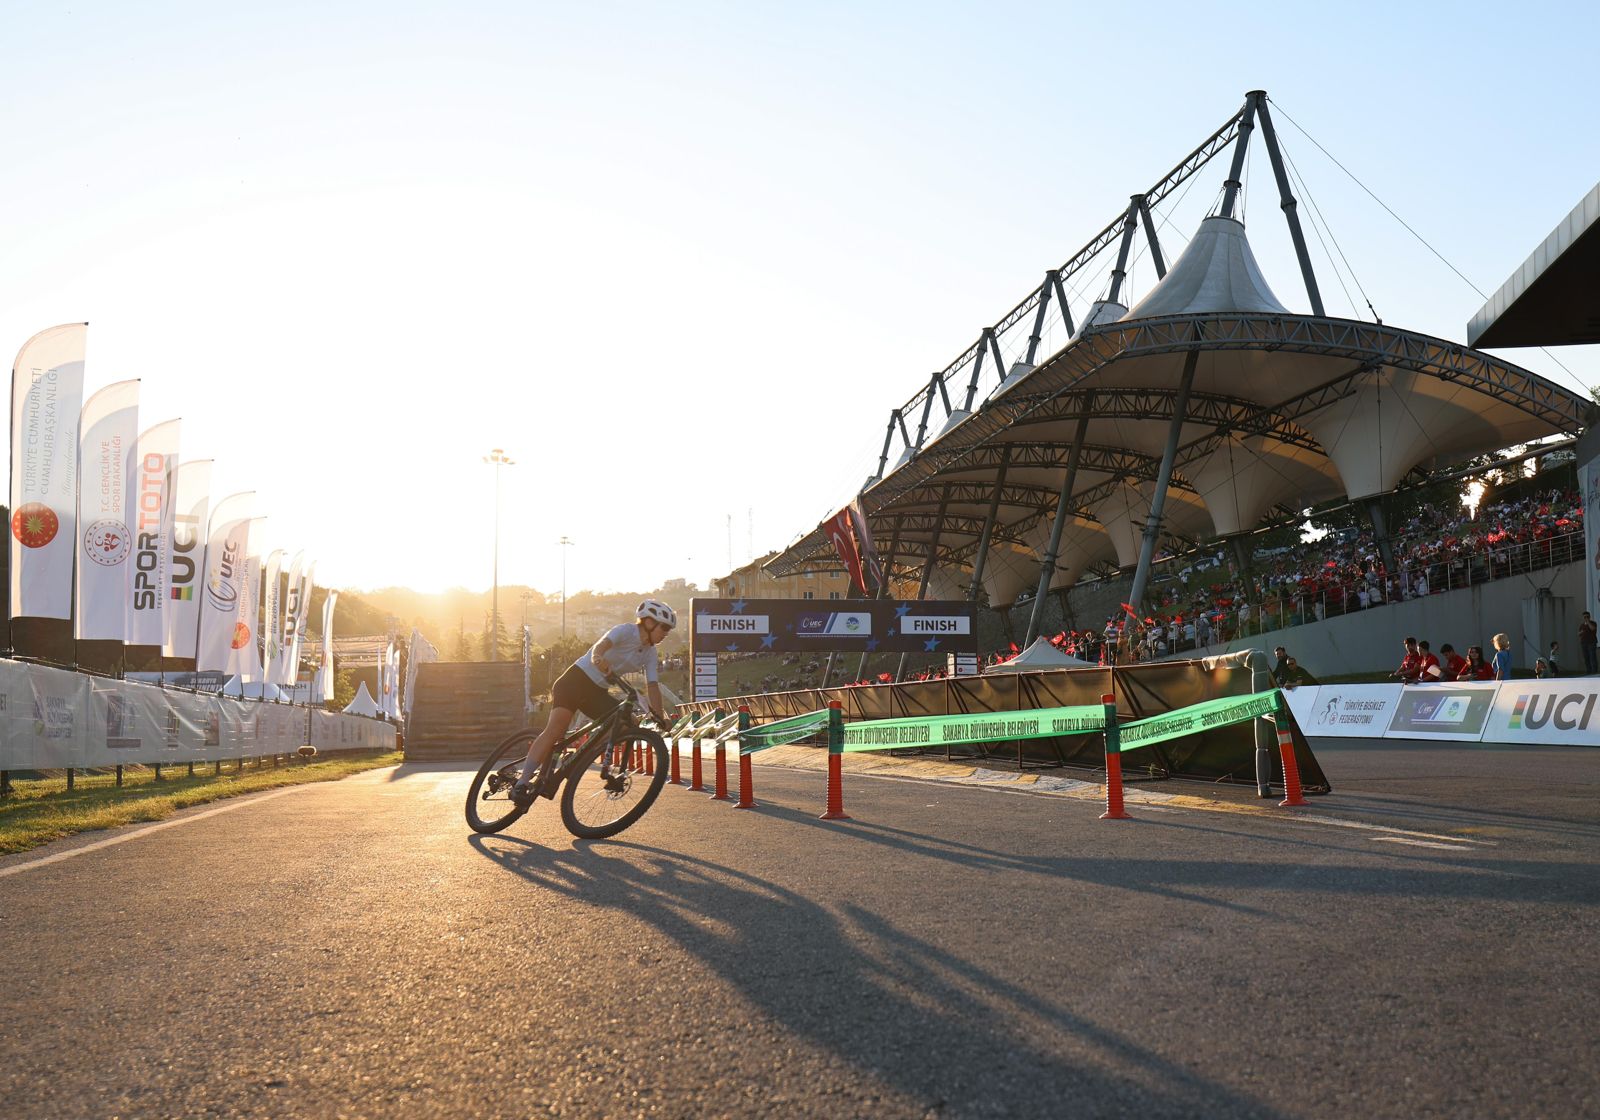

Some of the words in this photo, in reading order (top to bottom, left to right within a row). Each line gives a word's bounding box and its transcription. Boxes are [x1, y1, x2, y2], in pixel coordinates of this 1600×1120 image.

[28, 368, 42, 445] CUMHURİYETİ
[41, 369, 57, 495] CUMHURBAŞKANLIĞI
[139, 453, 164, 529] TOTO
[172, 514, 199, 583] UCI
[220, 539, 237, 578] UEC
[134, 533, 158, 610] SPOR
[286, 589, 298, 635] UCI
[711, 619, 755, 631] FINISH
[914, 620, 957, 631] FINISH
[943, 724, 969, 741] SAKARYA
[971, 719, 1006, 739] BÜYÜKŞEHİR
[1008, 717, 1039, 736] BELEDİYESİ
[1052, 718, 1079, 732] SAKARYA
[1525, 694, 1597, 731] UCI
[863, 726, 898, 745] BÜYÜKŞEHİR
[900, 723, 930, 743] BELEDİYESİ
